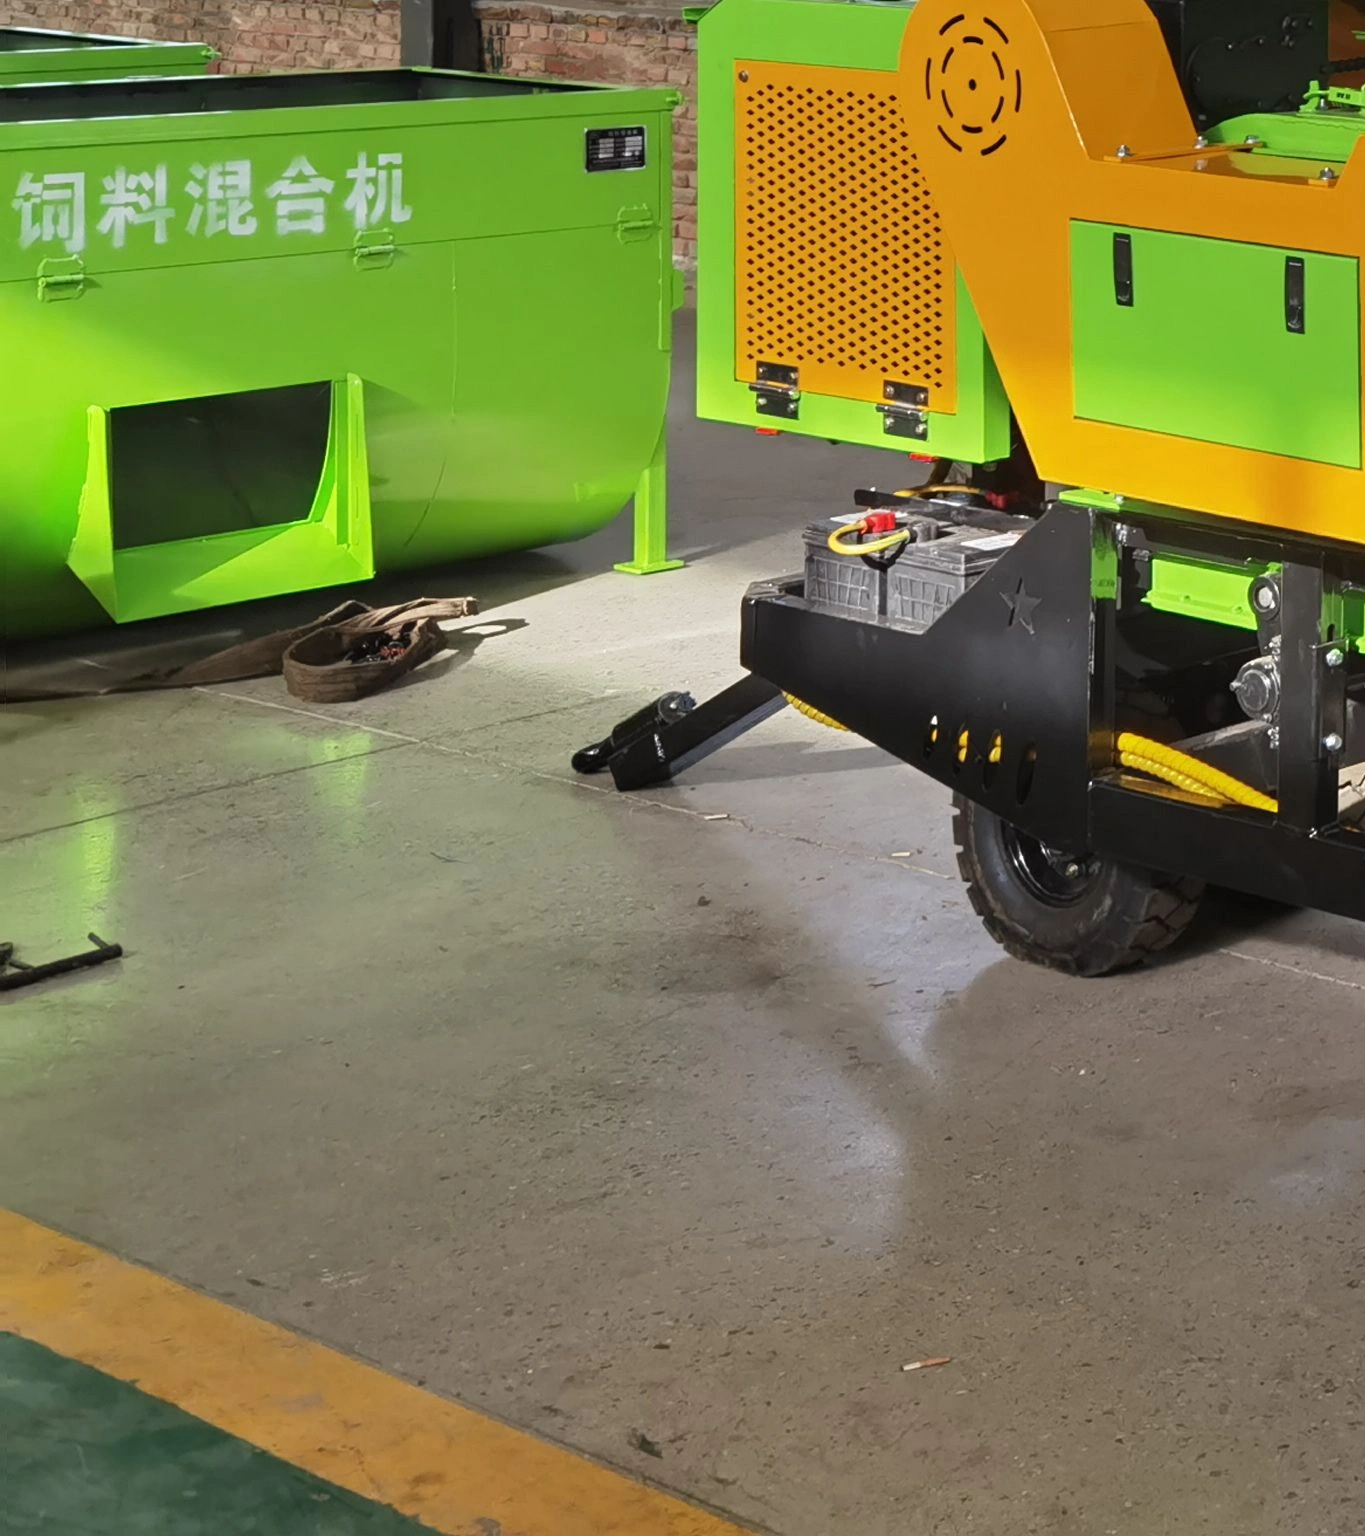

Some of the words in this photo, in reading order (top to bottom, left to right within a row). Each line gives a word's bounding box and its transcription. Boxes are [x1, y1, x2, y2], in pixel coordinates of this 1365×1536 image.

[11, 152, 413, 252] 饲料混合机
